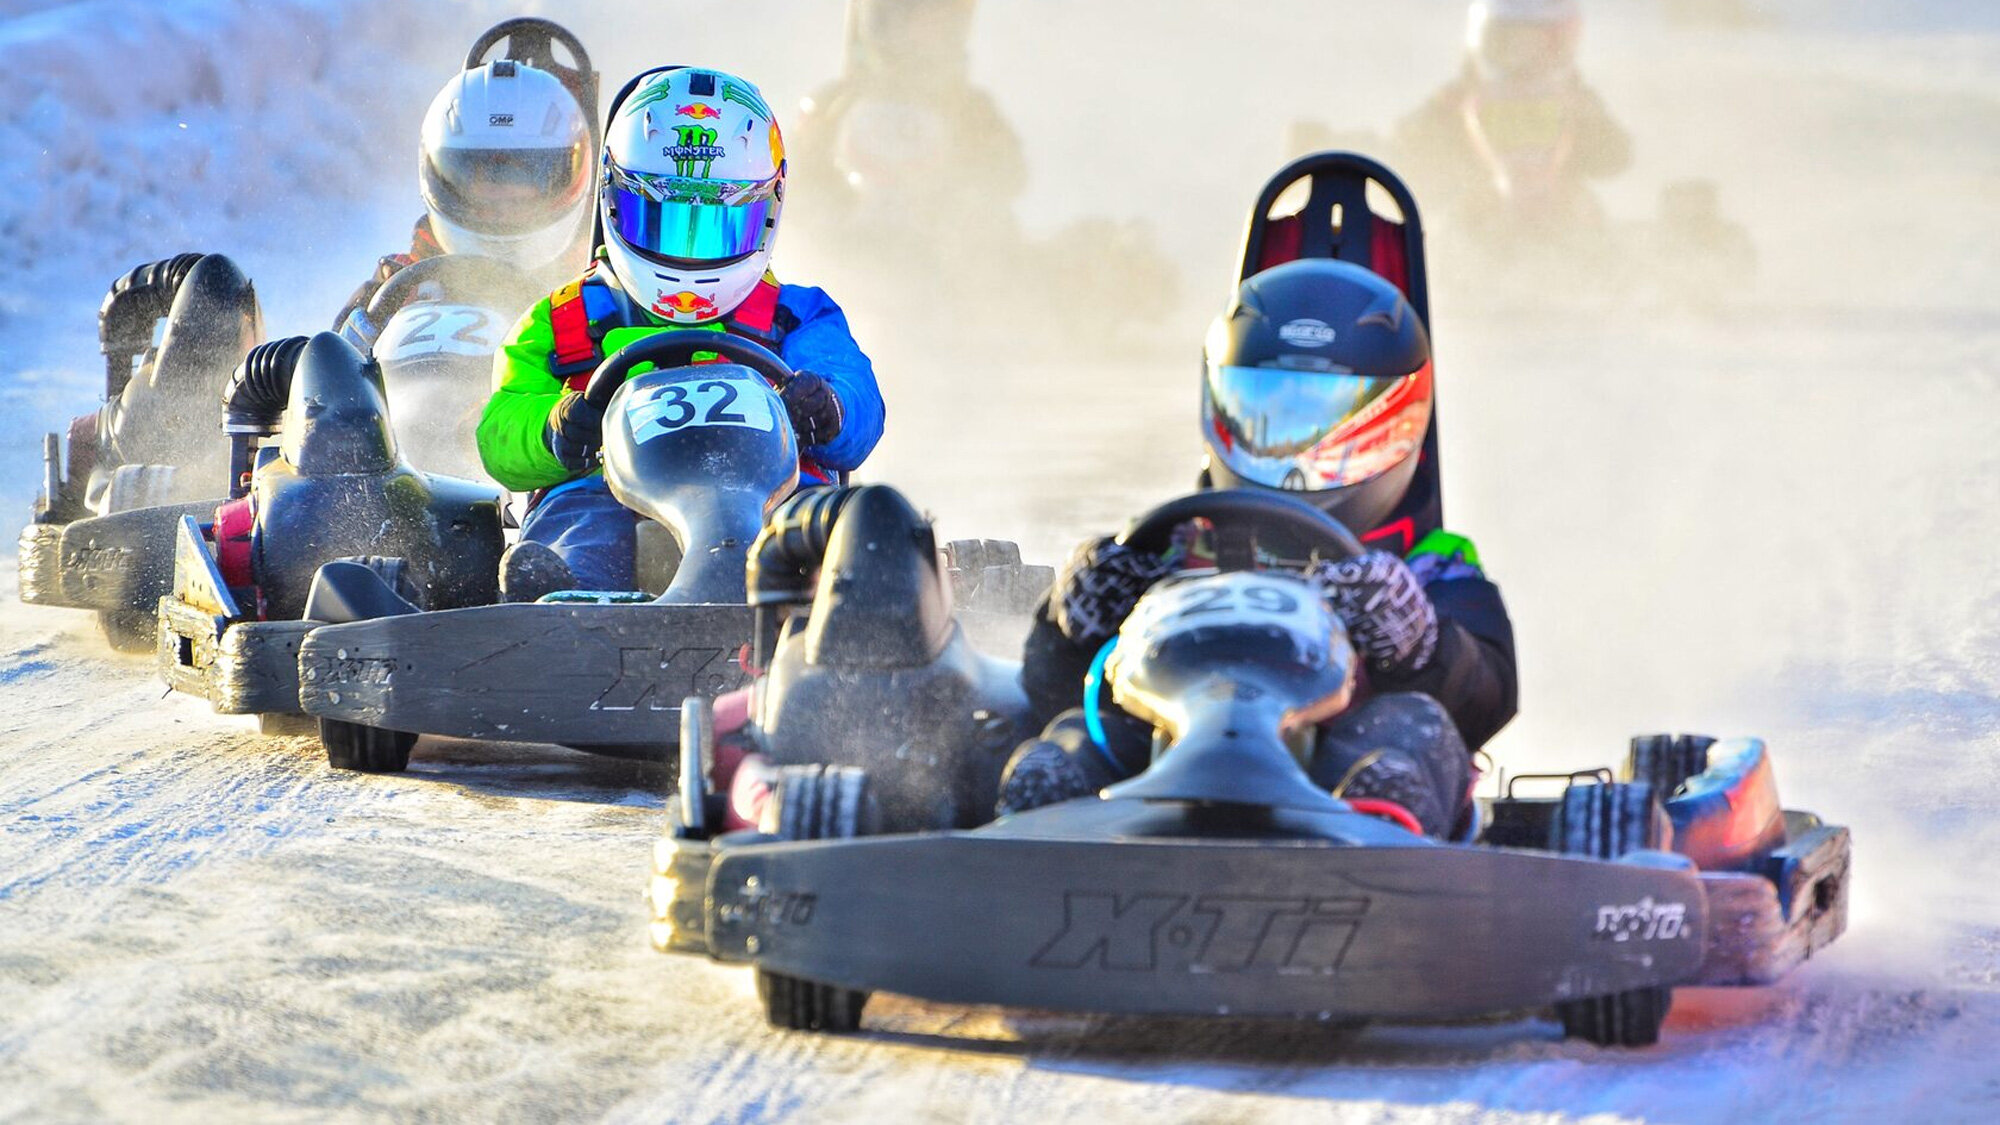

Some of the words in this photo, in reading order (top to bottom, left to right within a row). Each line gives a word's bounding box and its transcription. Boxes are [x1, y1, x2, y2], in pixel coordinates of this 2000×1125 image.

[489, 115, 514, 125] OMP
[663, 147, 725, 157] MONSTER
[399, 310, 489, 347] 22
[651, 381, 756, 429] 32
[1180, 586, 1298, 617] 29
